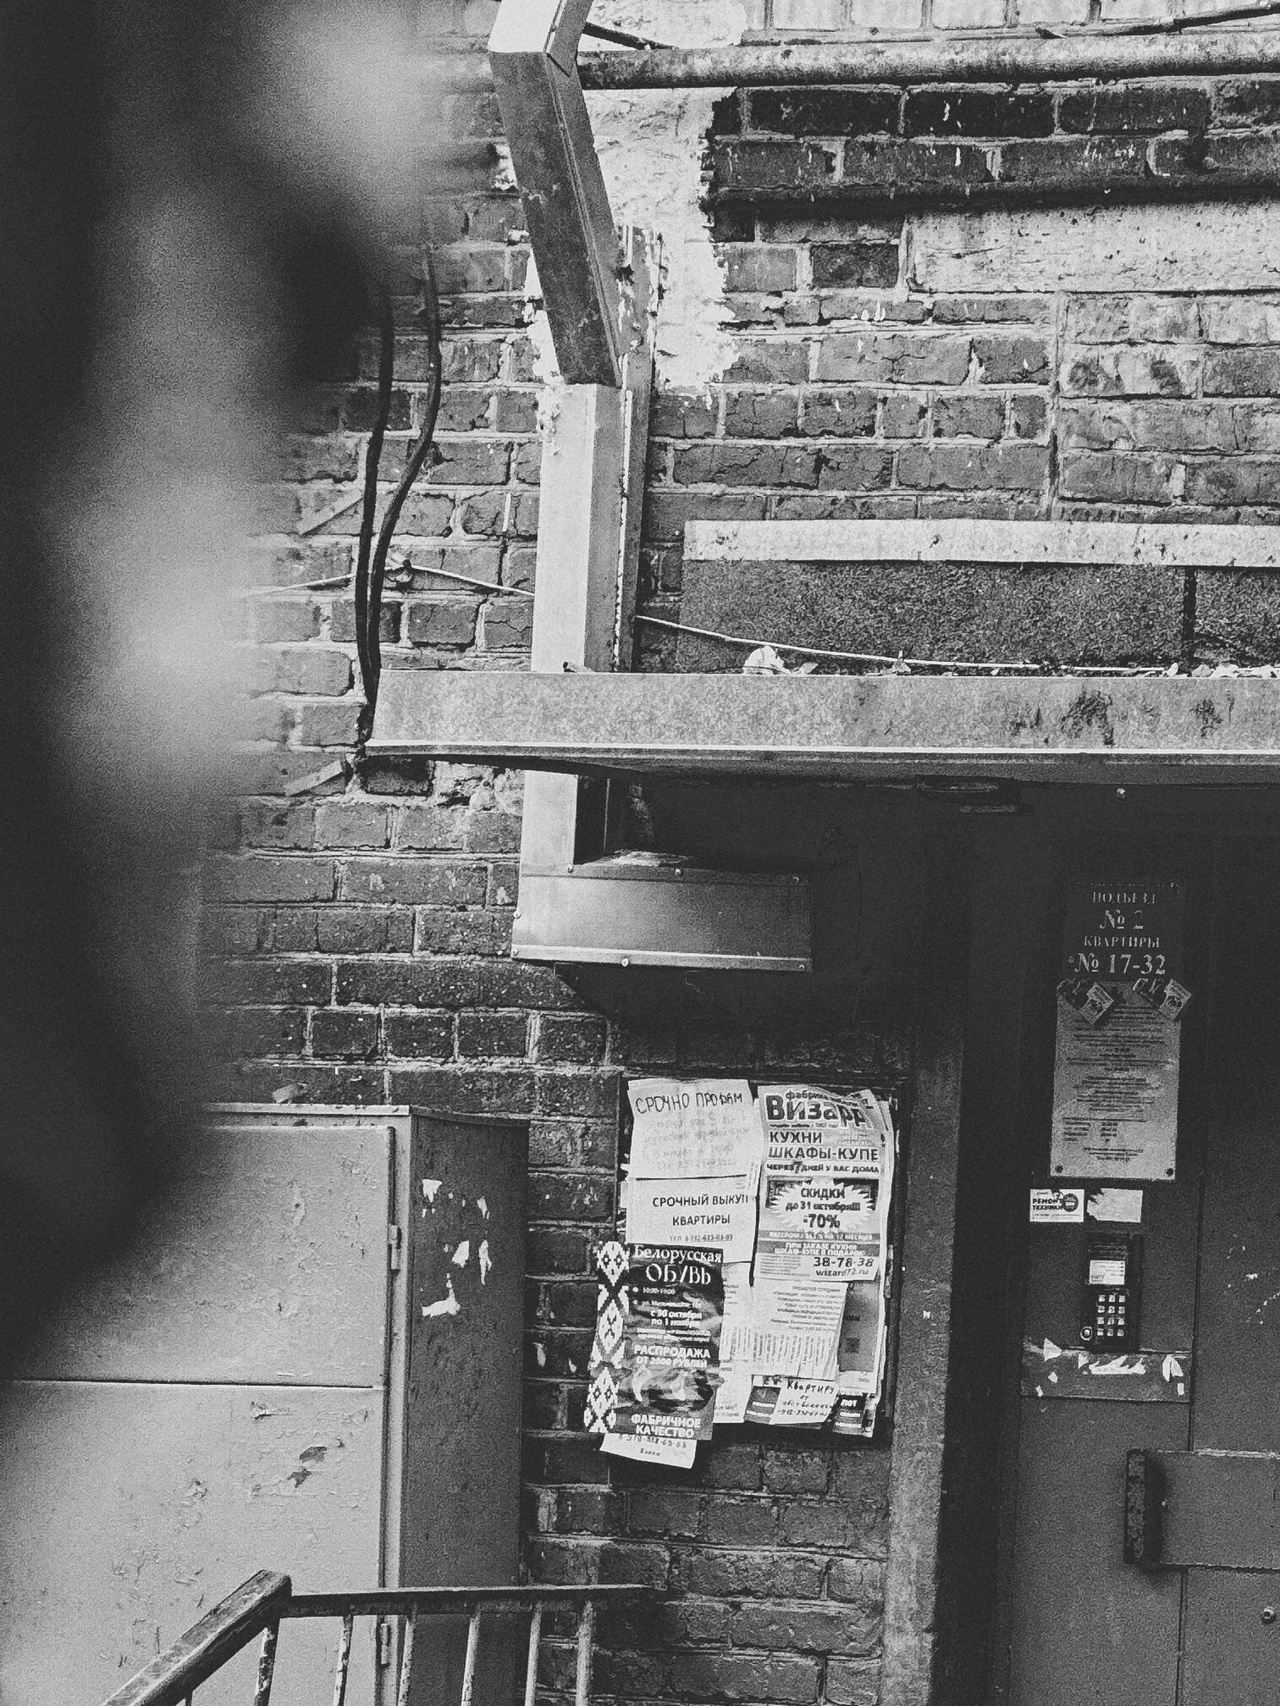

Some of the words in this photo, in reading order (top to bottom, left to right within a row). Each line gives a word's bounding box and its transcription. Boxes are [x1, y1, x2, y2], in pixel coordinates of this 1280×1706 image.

[1133, 909, 1144, 929] 2
[1084, 936, 1160, 948] КВАРТИРЫ
[1109, 954, 1166, 974] 17-32
[635, 1093, 690, 1114] СРОЧНО
[696, 1092, 743, 1108] ПРОДАМ
[769, 1131, 823, 1144] КУХНИ
[768, 1146, 880, 1161] ШКАФЫ-КУПЕ
[851, 1166, 880, 1174] ДОМА
[652, 1193, 709, 1208] СРОЧНЫЙ
[712, 1194, 749, 1206] ВЫКУП
[801, 1187, 845, 1200] СКИДКИ
[785, 1203, 799, 1212] до
[800, 1201, 812, 1210] 31
[672, 1214, 731, 1227] КВАРТИРЫ
[633, 1243, 722, 1265] Белорусская
[634, 1344, 711, 1359] РАСПРОДАЖА
[631, 1413, 702, 1429] ФАБРИЧНОЕ
[636, 1424, 695, 1439] КАЧЕСТВО
